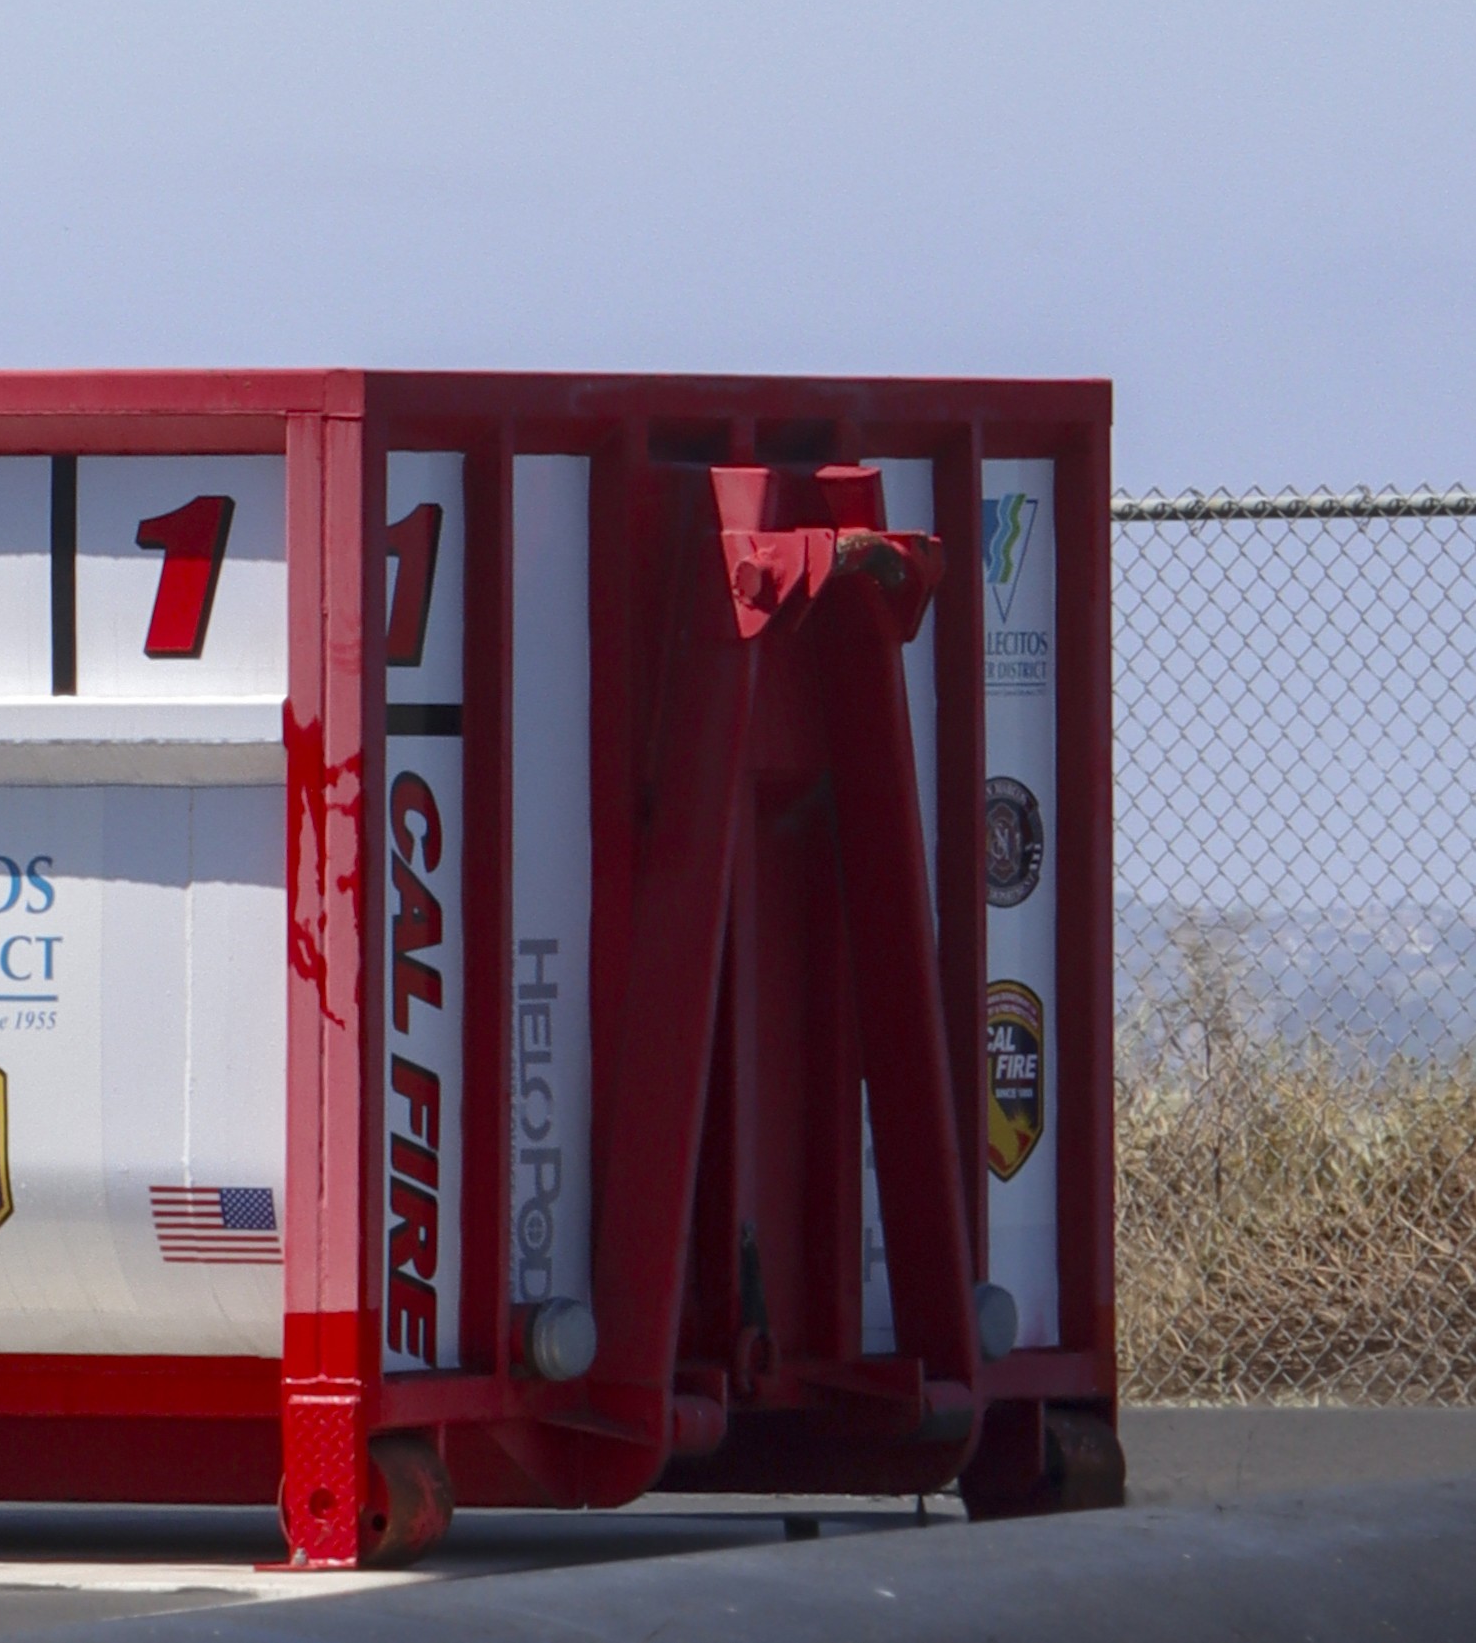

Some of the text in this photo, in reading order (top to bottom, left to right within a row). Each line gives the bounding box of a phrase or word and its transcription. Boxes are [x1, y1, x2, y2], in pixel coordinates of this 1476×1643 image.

[135, 495, 236, 660] 1
[386, 501, 444, 668] 1
[13, 1011, 58, 1032] 1955
[386, 769, 443, 1370] CAL FIRE
[995, 1053, 1038, 1079] FIRE
